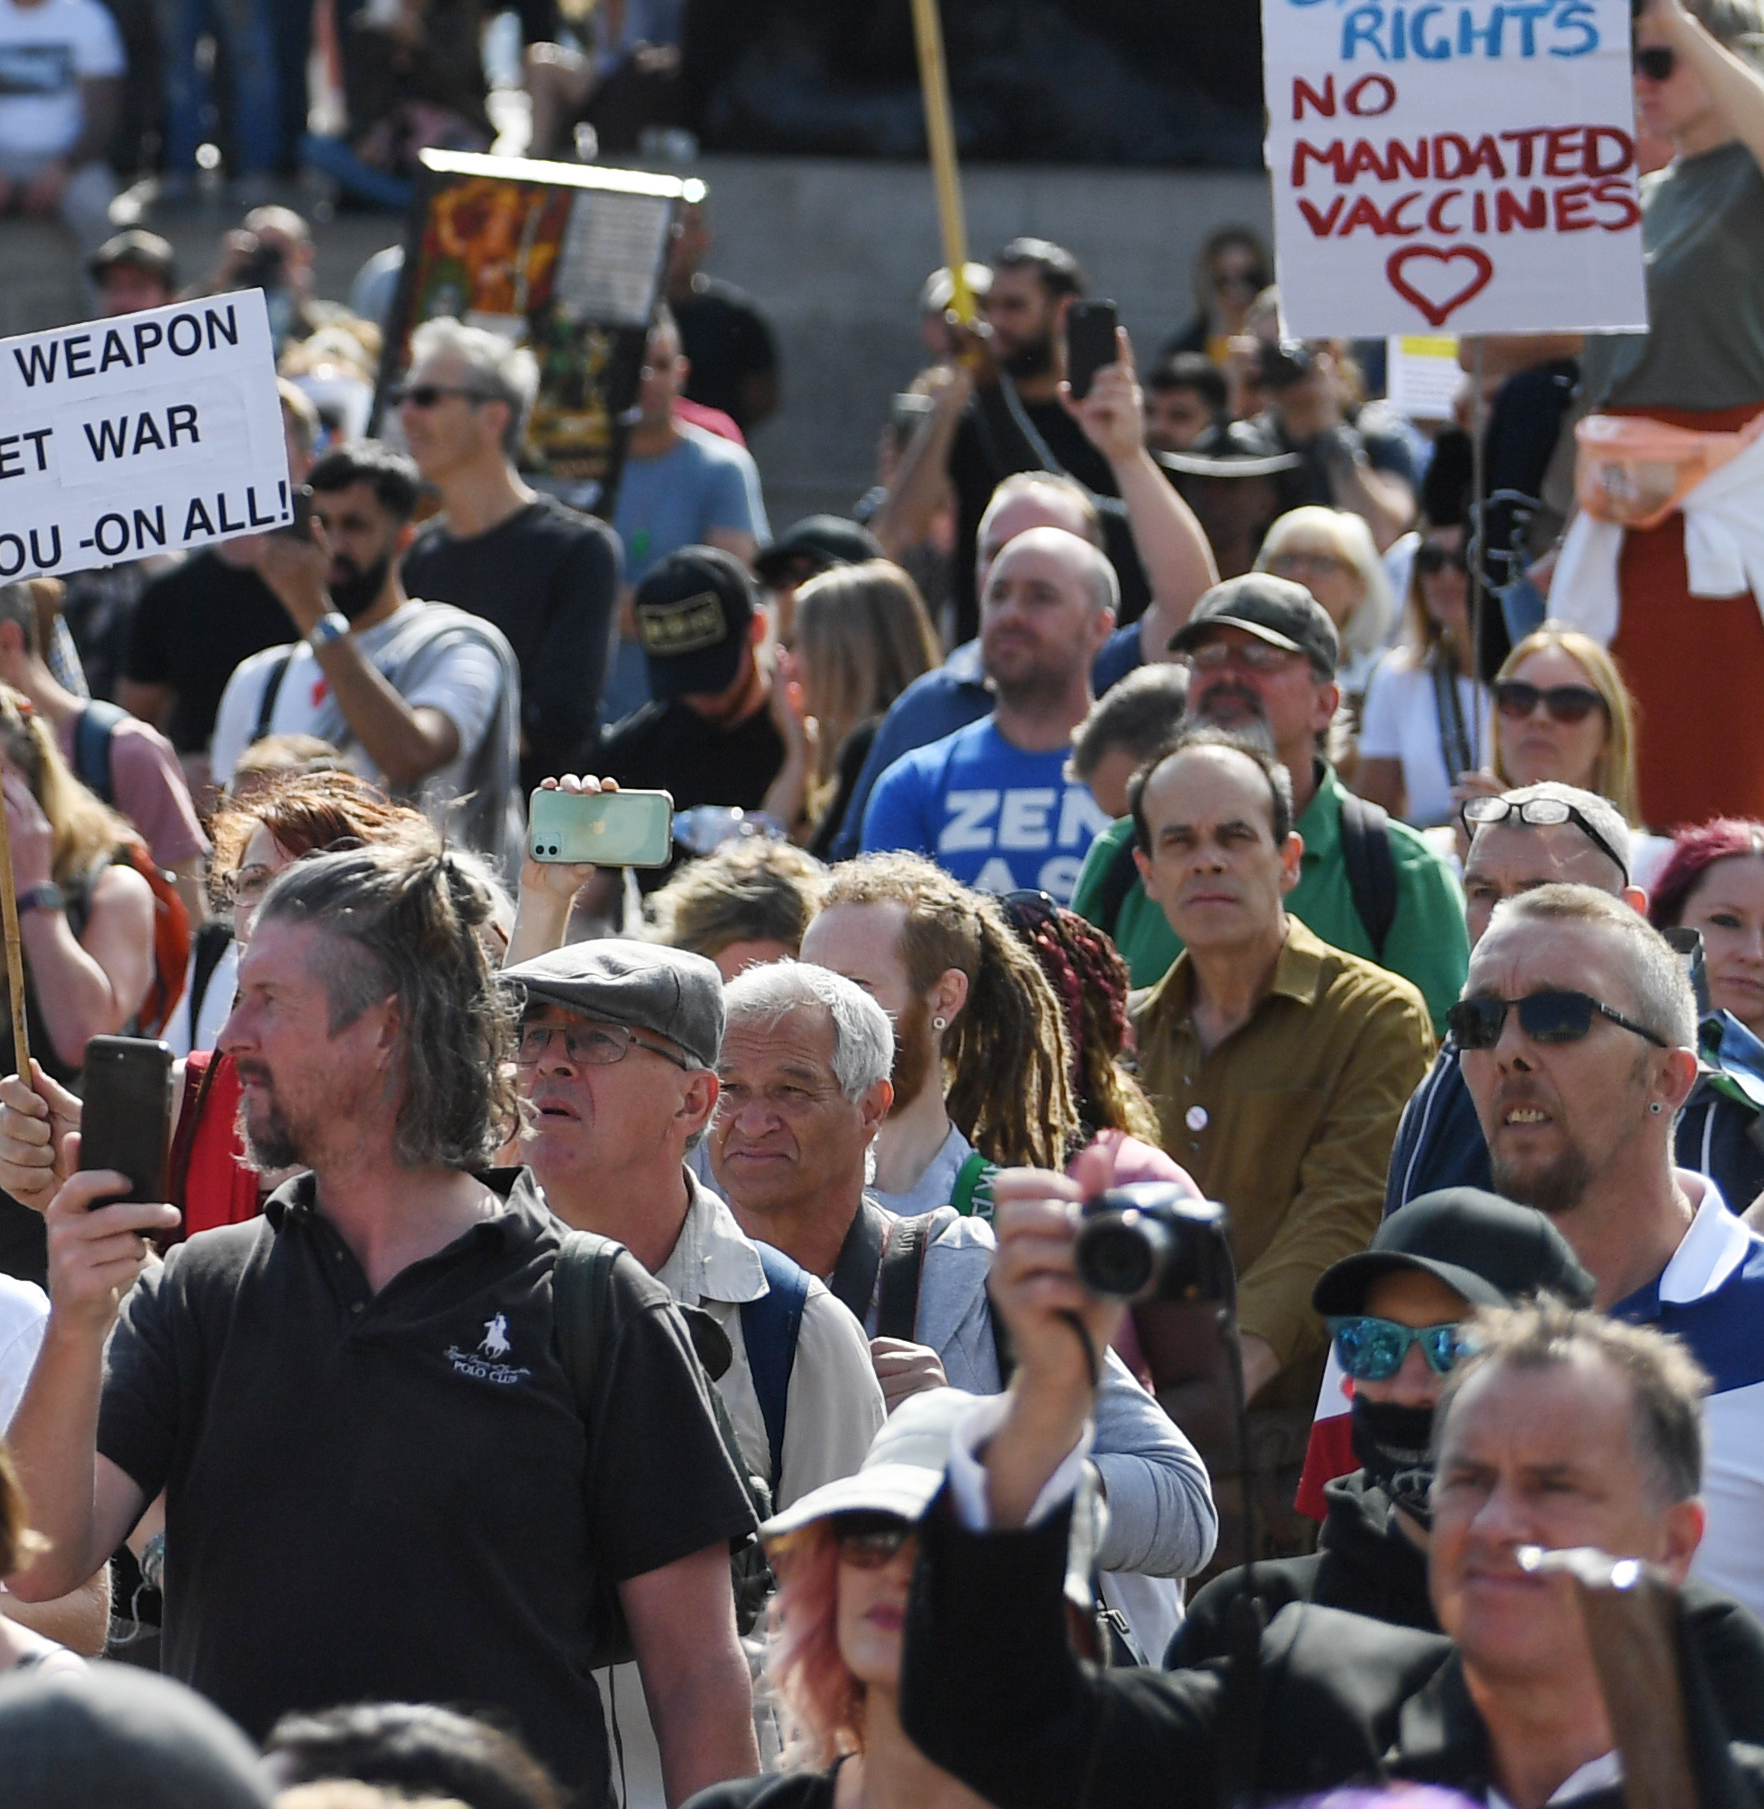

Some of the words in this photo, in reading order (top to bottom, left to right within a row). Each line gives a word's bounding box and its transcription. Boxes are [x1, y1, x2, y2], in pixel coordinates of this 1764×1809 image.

[1340, 1, 1601, 62] RIGHTS
[1291, 71, 1397, 122] NO
[1290, 123, 1637, 188] MANDATED
[1296, 176, 1643, 238] VACCINES
[12, 303, 240, 388] WEAPON
[82, 403, 202, 463] WAR
[181, 479, 293, 542] ALL!
[454, 1360, 486, 1378] POLO
